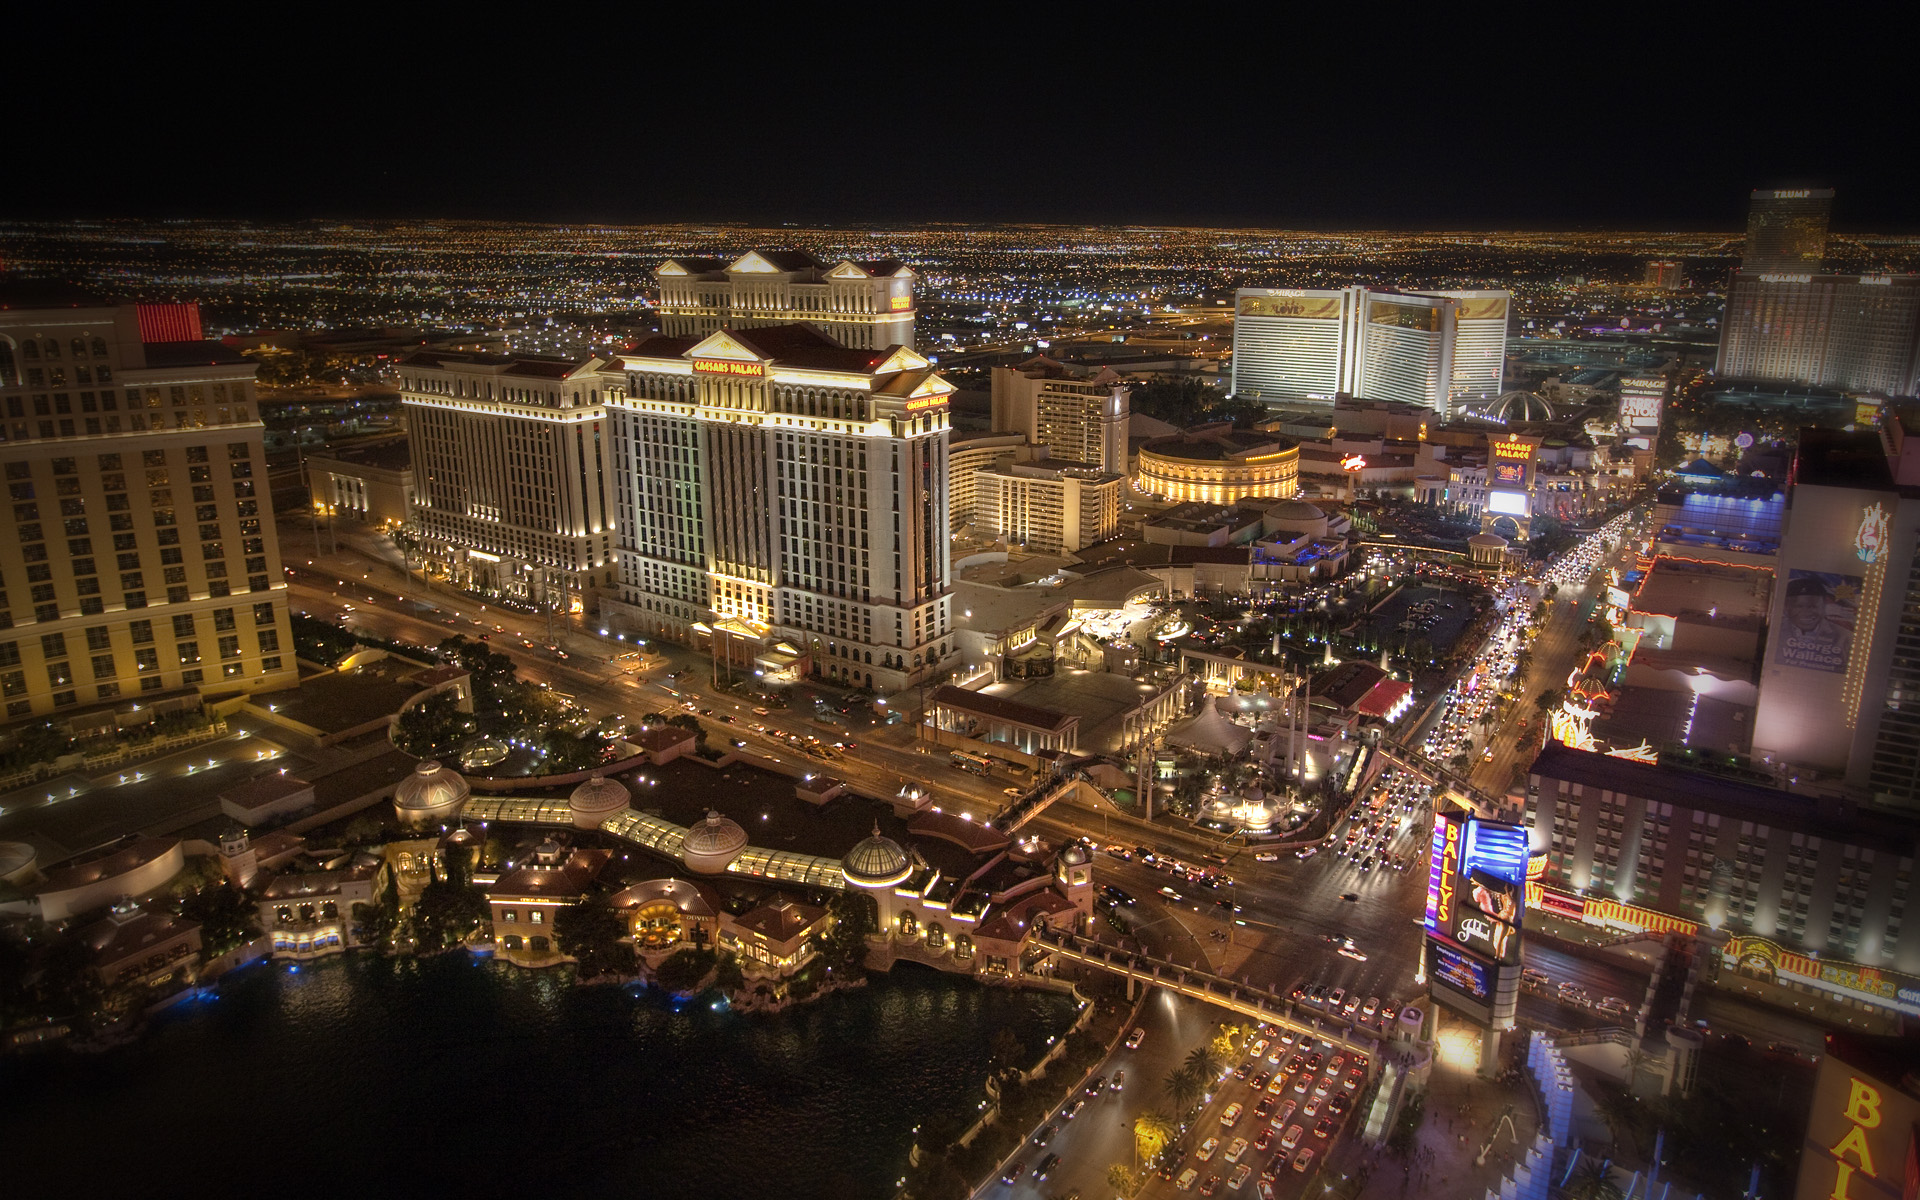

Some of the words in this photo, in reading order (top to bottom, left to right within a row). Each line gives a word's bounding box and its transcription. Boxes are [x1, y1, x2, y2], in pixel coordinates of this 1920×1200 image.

[1773, 190, 1810, 199] TRUMP
[695, 361, 728, 373] CAESARS
[730, 363, 763, 376] PALACE
[1631, 380, 1666, 388] MIRAGE
[907, 399, 929, 411] CAESARS
[1622, 397, 1660, 408] TERRY
[1621, 405, 1658, 416] FATOR
[1495, 441, 1532, 452] CAESARS
[1496, 449, 1529, 459] PALACE
[1786, 637, 1842, 654] George
[1782, 647, 1843, 665] Wallace
[1438, 823, 1459, 922] BALLYS
